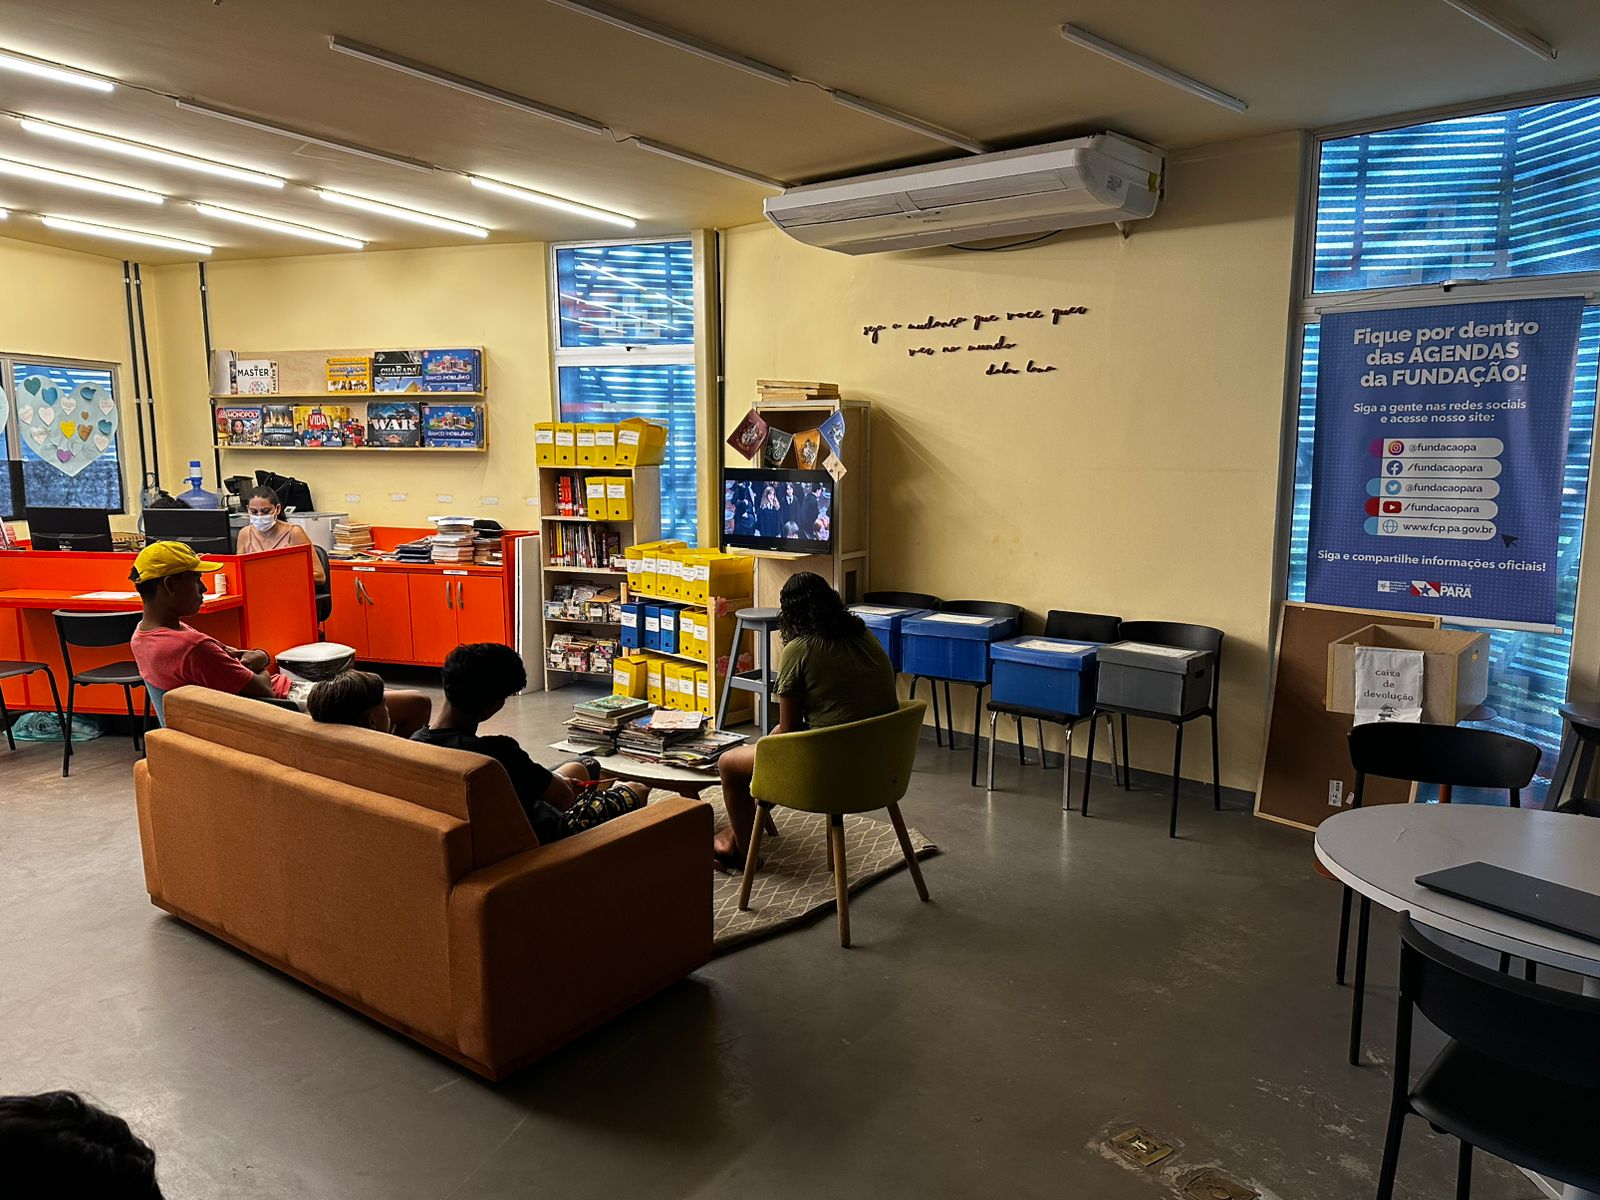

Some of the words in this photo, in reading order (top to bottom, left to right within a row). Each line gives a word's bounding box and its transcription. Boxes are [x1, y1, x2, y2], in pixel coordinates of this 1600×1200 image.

[973, 314, 1000, 331] que
[1353, 328, 1412, 348] Fique
[1416, 326, 1455, 345] por
[1458, 319, 1539, 339] dentro
[967, 335, 1017, 351] mundo
[1366, 349, 1405, 365] das
[1408, 341, 1520, 364] AGENDAS
[237, 368, 269, 377] MASTER
[1360, 370, 1388, 387] da
[1392, 361, 1528, 388] FUNDAÇÃO!
[1353, 403, 1378, 415] Siga
[1389, 403, 1423, 414] gente
[1425, 403, 1447, 411] nas
[1449, 400, 1483, 410] redes
[1485, 399, 1527, 410] sociais
[309, 415, 327, 426] VIDA
[1390, 414, 1428, 423] acesse
[1431, 414, 1466, 423] nosso
[1468, 412, 1495, 422] site:
[371, 418, 418, 430] WAR
[1408, 443, 1477, 453] @fundacaopa
[1407, 463, 1483, 474] /fundacaopara
[1405, 483, 1483, 494] @fundacaopara
[1404, 503, 1480, 514] /fundacaopara
[1403, 523, 1494, 535] www.fcp.pa.gov.br
[1318, 549, 1341, 561] Siga
[1352, 553, 1419, 564] compartilhe
[1421, 555, 1495, 570] informações
[1498, 560, 1546, 572] oficiais!
[1375, 669, 1401, 678] caixa
[1363, 690, 1414, 702] devolução
